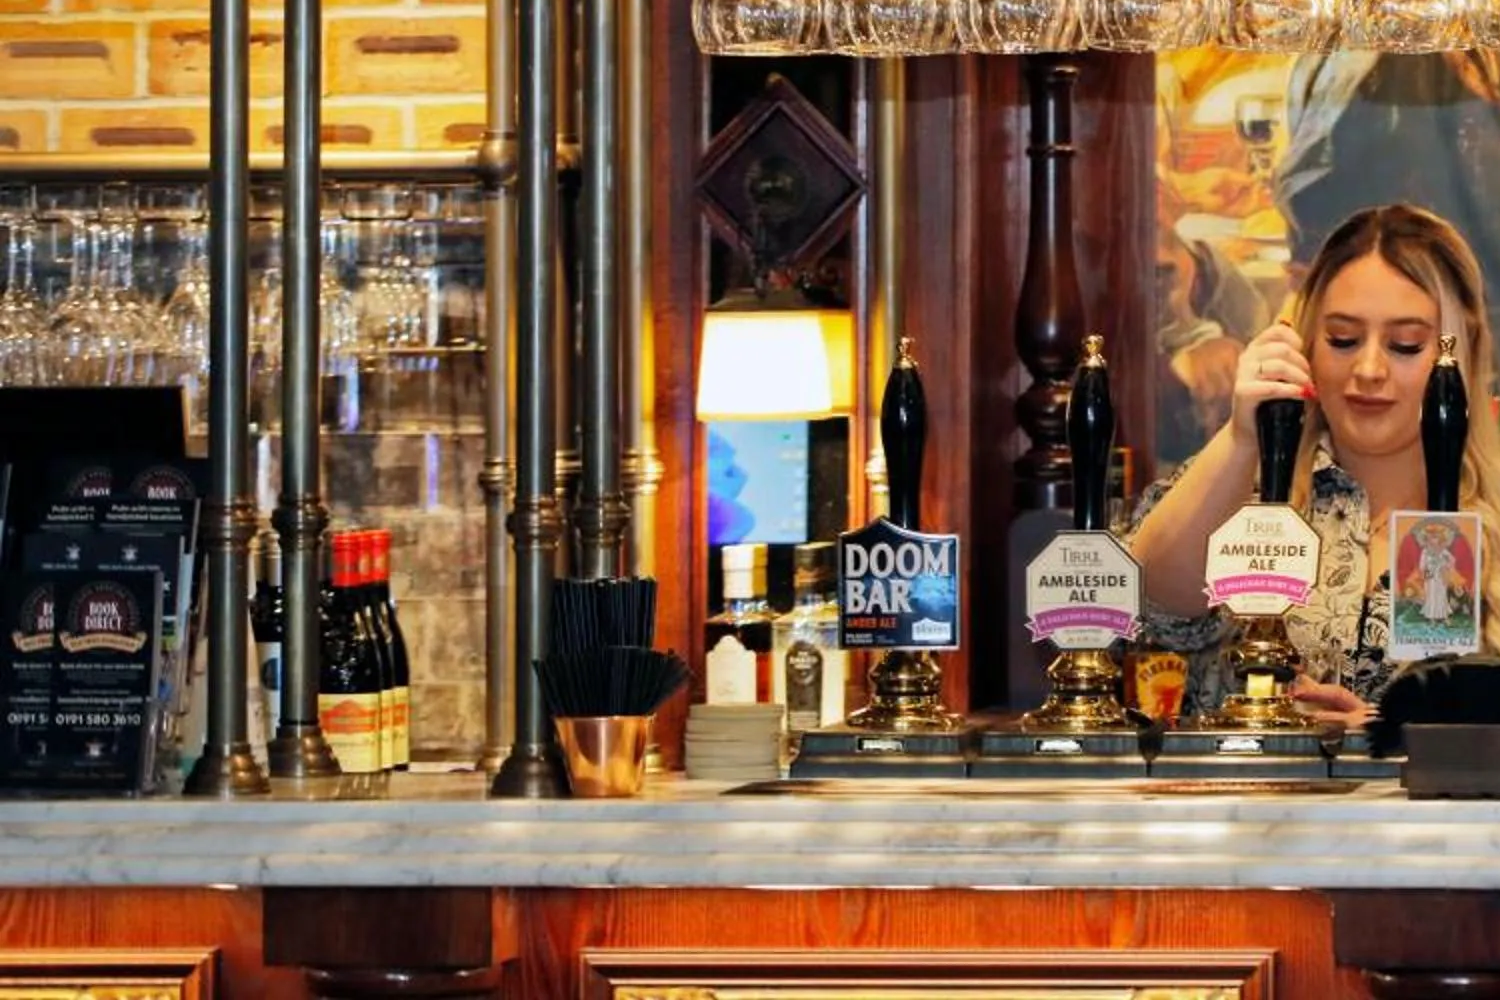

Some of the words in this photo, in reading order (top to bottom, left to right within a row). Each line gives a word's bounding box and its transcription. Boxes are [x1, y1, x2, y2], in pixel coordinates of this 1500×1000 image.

[1220, 544, 1308, 557] AMBLESIDE
[845, 542, 952, 578] DOOM
[1248, 559, 1276, 571] ALE
[1038, 575, 1128, 588] AMBLESIDE
[845, 579, 914, 614] BAR
[1068, 590, 1097, 603] ALE
[89, 602, 118, 616] BOOK
[84, 616, 122, 630] DIRECT
[55, 712, 83, 725] 0191
[86, 712, 110, 725] 580
